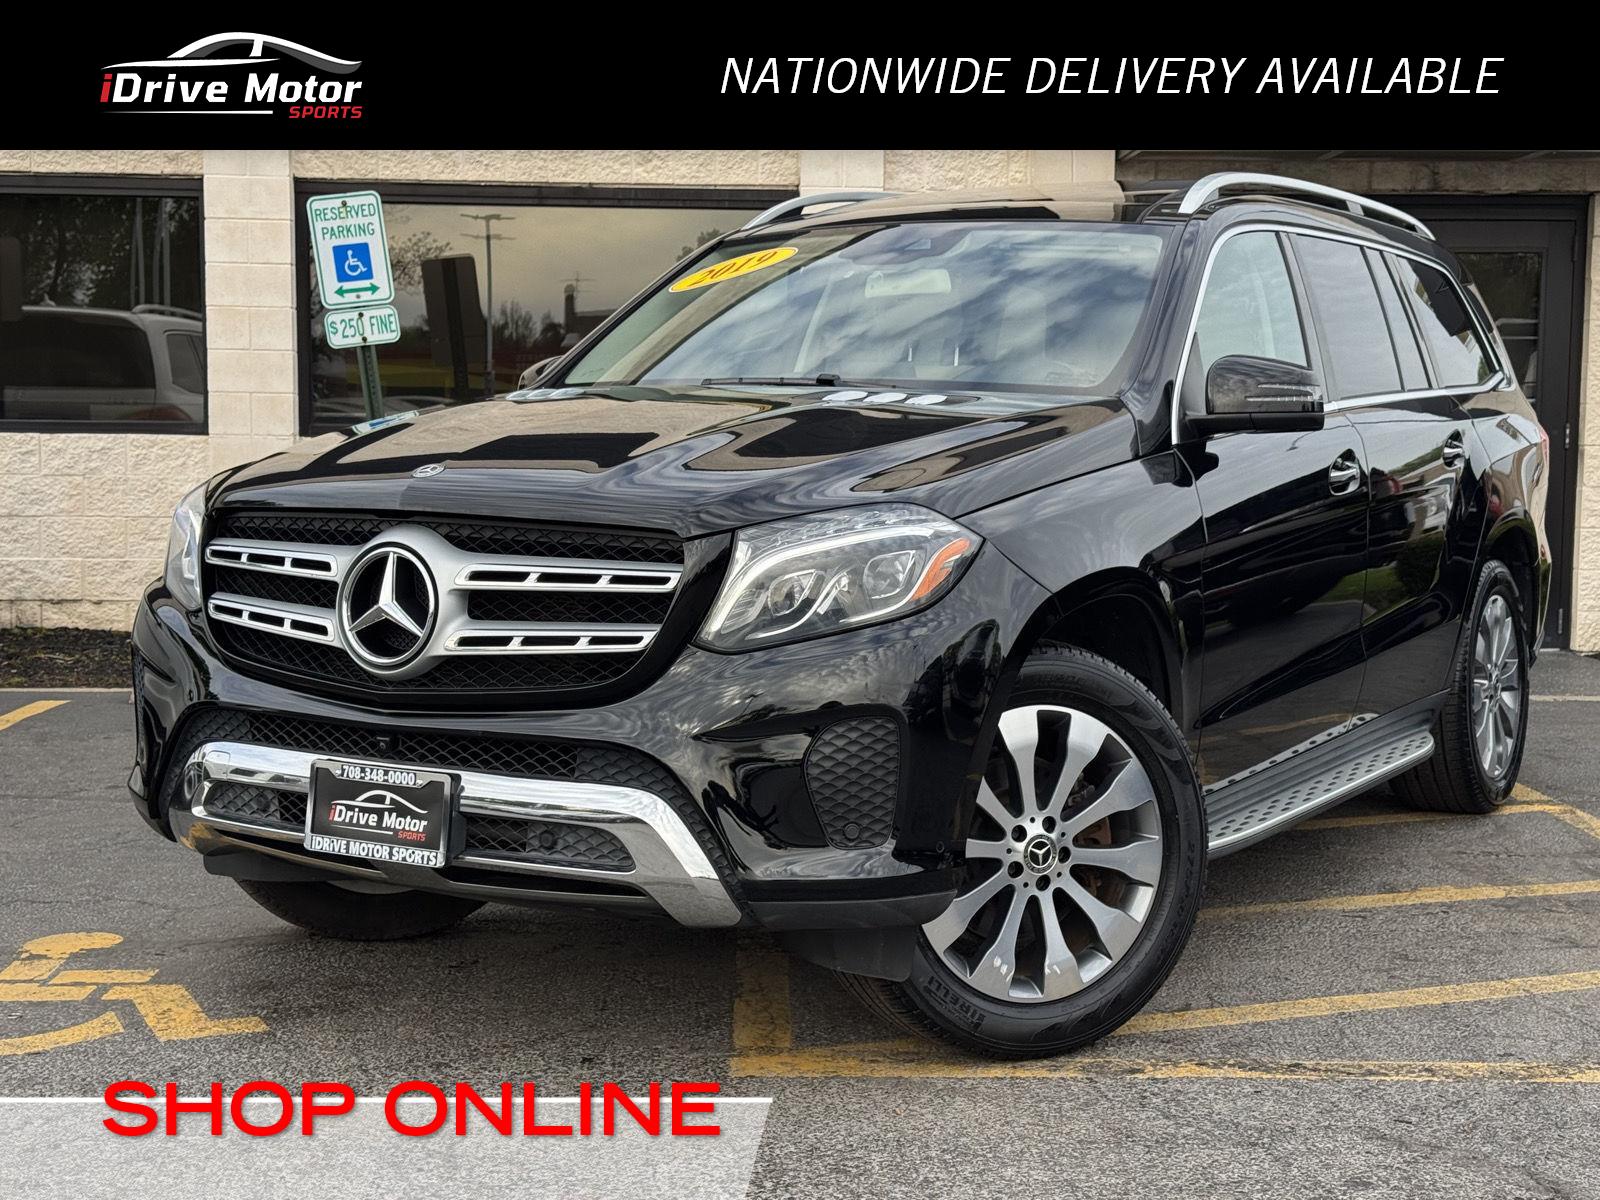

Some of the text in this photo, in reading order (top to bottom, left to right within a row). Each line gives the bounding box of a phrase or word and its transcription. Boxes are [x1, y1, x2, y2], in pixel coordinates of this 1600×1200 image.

[314, 203, 376, 223] RESERVED
[321, 222, 375, 240] PARKING
[688, 251, 778, 286] 2019
[329, 313, 396, 338] $250 FINE
[342, 765, 416, 785] 708-348-0000
[328, 804, 428, 832] iDrive Motor
[397, 830, 427, 842] SPORTS
[349, 840, 390, 860] MOTOR
[392, 848, 437, 866] SPORTS
